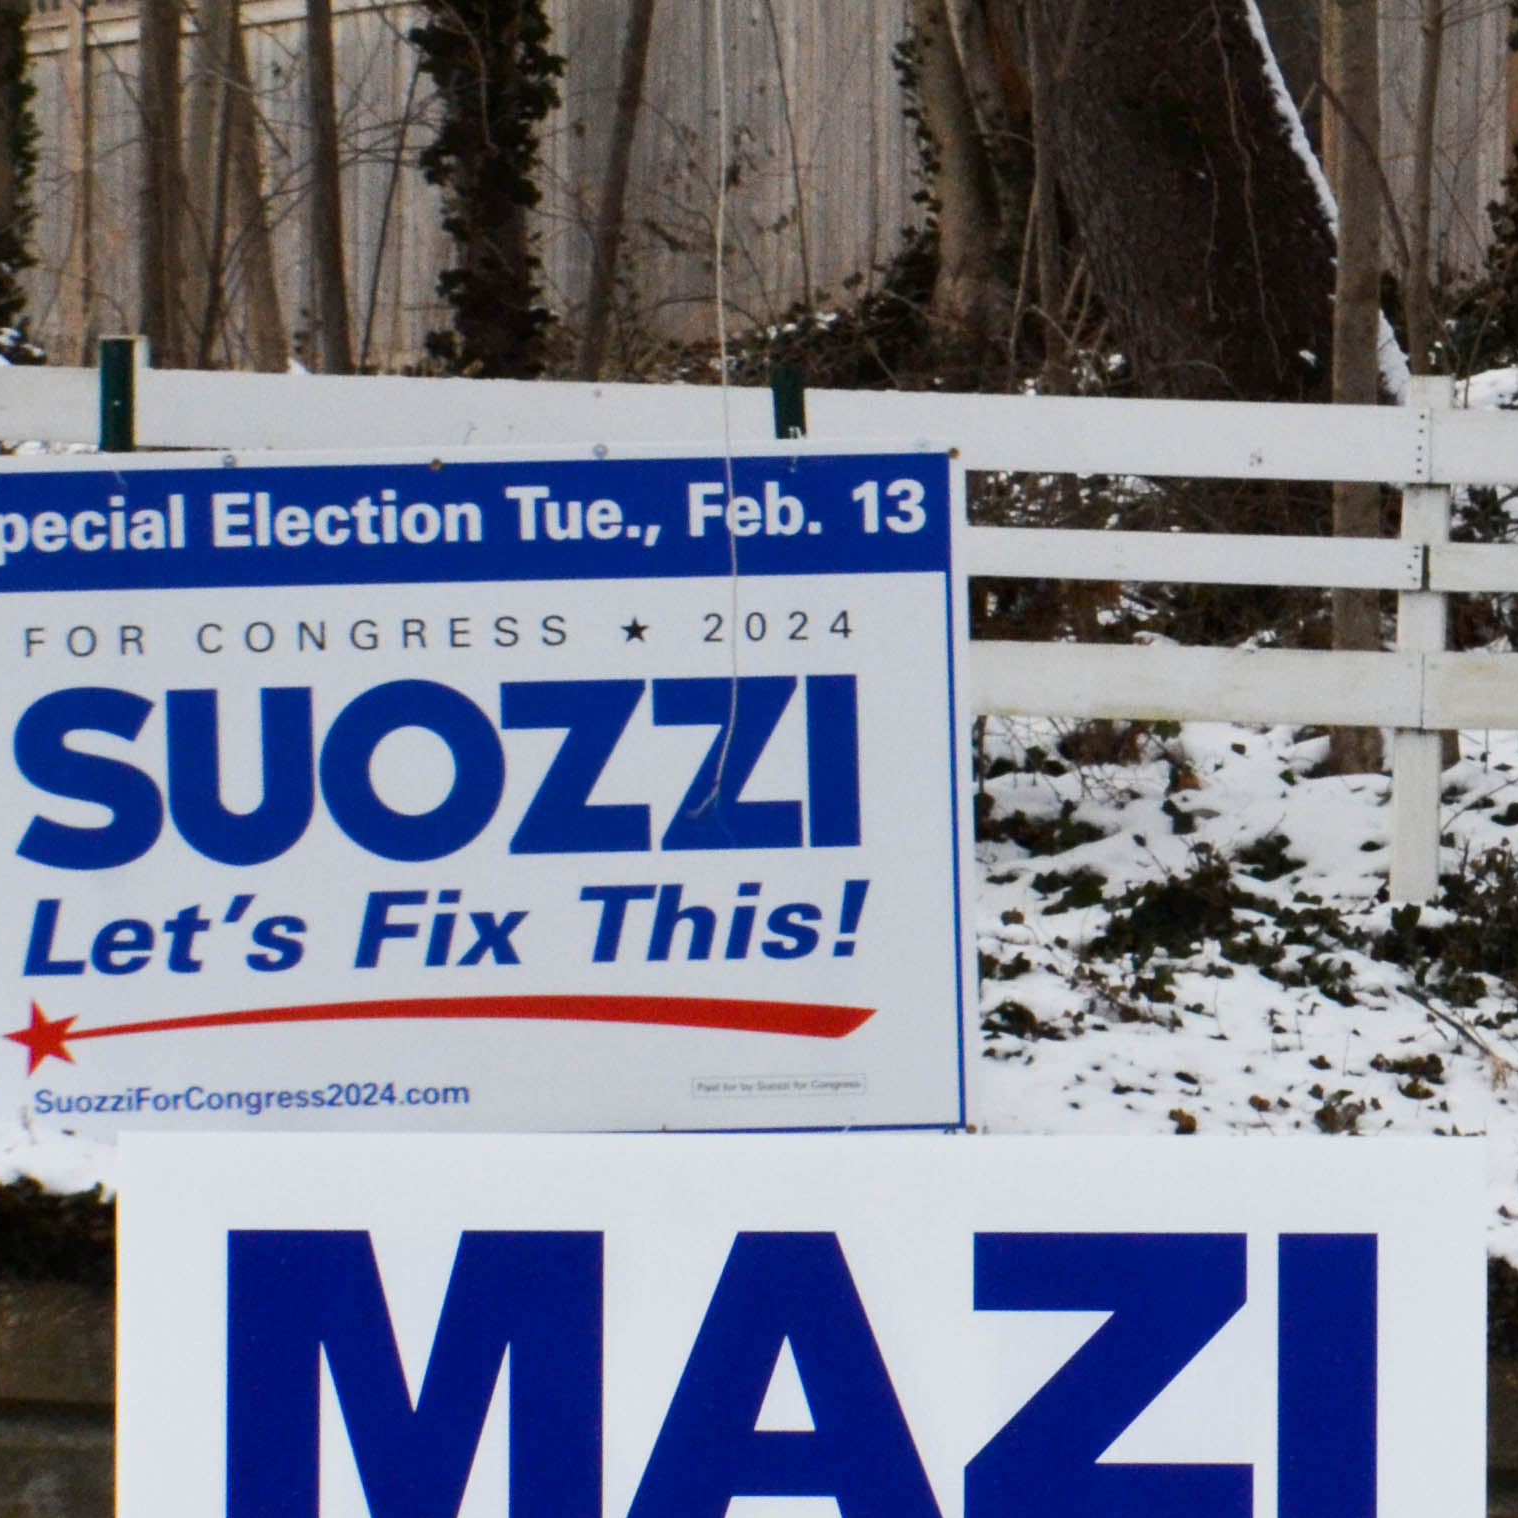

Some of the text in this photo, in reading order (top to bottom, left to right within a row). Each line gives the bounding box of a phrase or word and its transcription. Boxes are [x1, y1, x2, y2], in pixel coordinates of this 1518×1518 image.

[212, 488, 483, 550] Election
[506, 486, 661, 548] Tue.,
[688, 481, 821, 538] Feb.
[853, 478, 927, 534] 13
[24, 609, 854, 659] FOR CONGRESS 2024
[12, 672, 861, 871] SUOZZI
[23, 879, 870, 977] Let's Fix This!
[33, 1083, 470, 1116] SuozziForCongress2024.com
